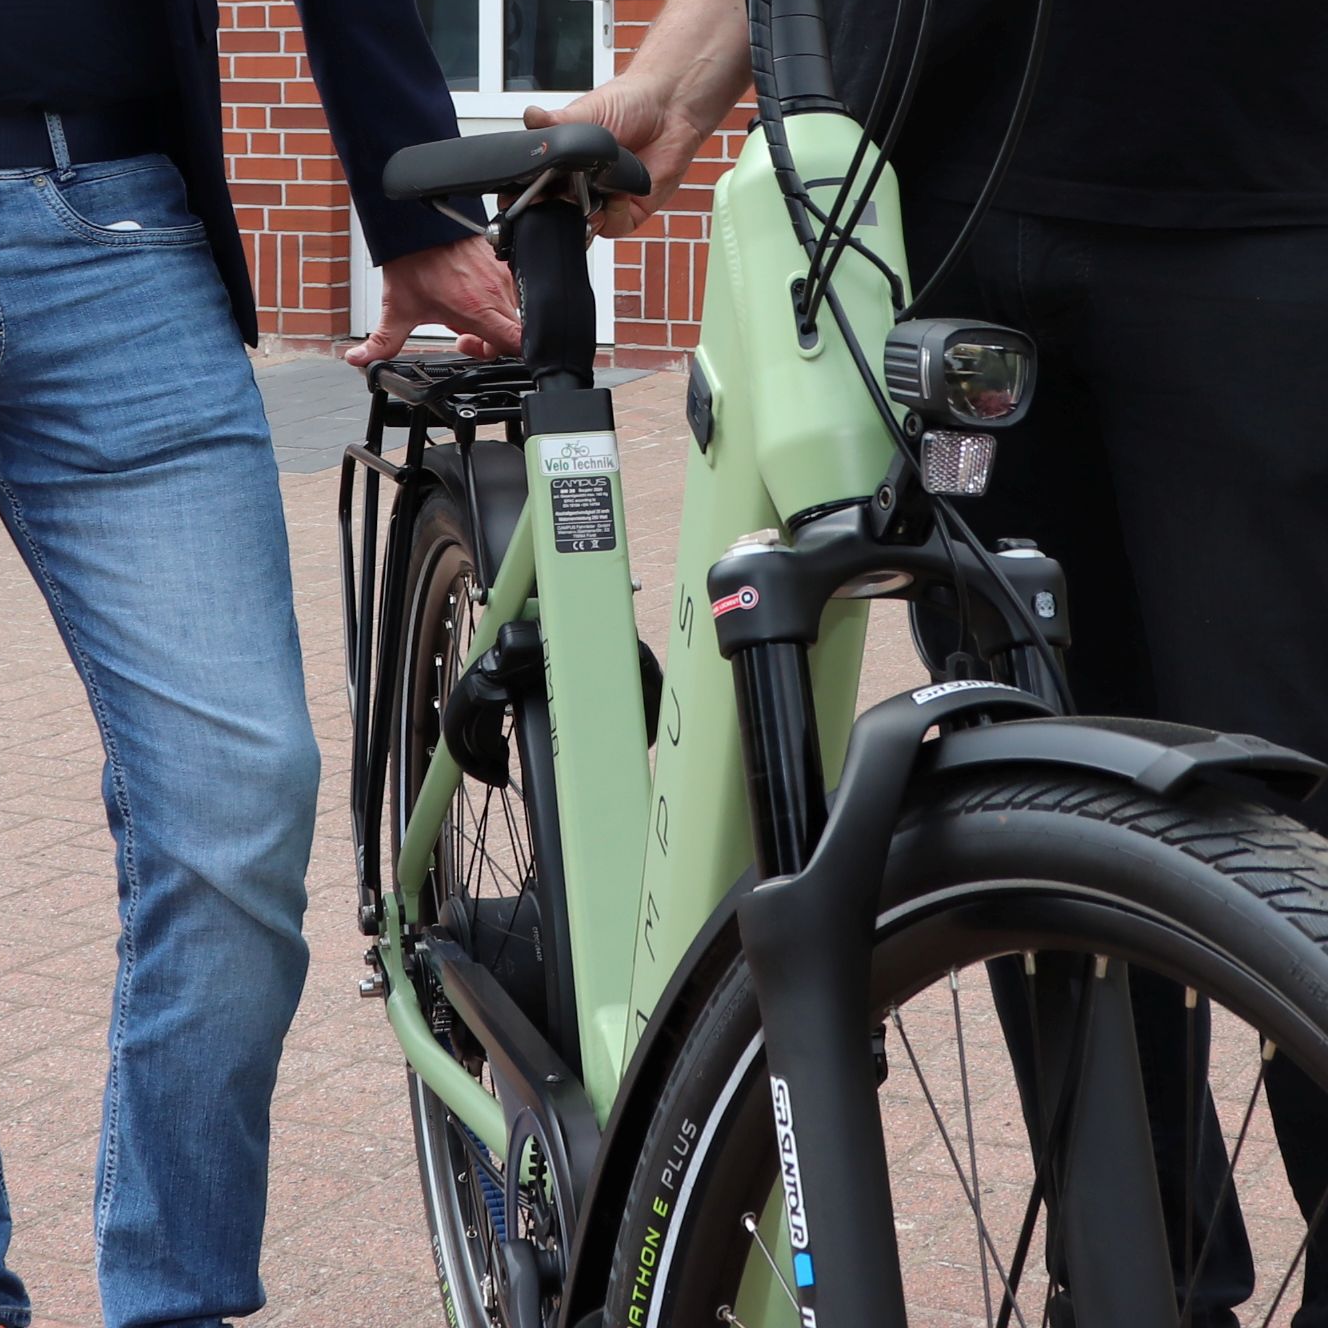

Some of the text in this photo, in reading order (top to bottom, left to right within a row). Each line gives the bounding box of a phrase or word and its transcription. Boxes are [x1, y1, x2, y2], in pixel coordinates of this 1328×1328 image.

[544, 457, 615, 472] Velo Technik
[553, 478, 607, 488] CAMPUS
[779, 1130, 806, 1244] SUNTOUR
[627, 1118, 698, 1327] ATHON E PLUS
